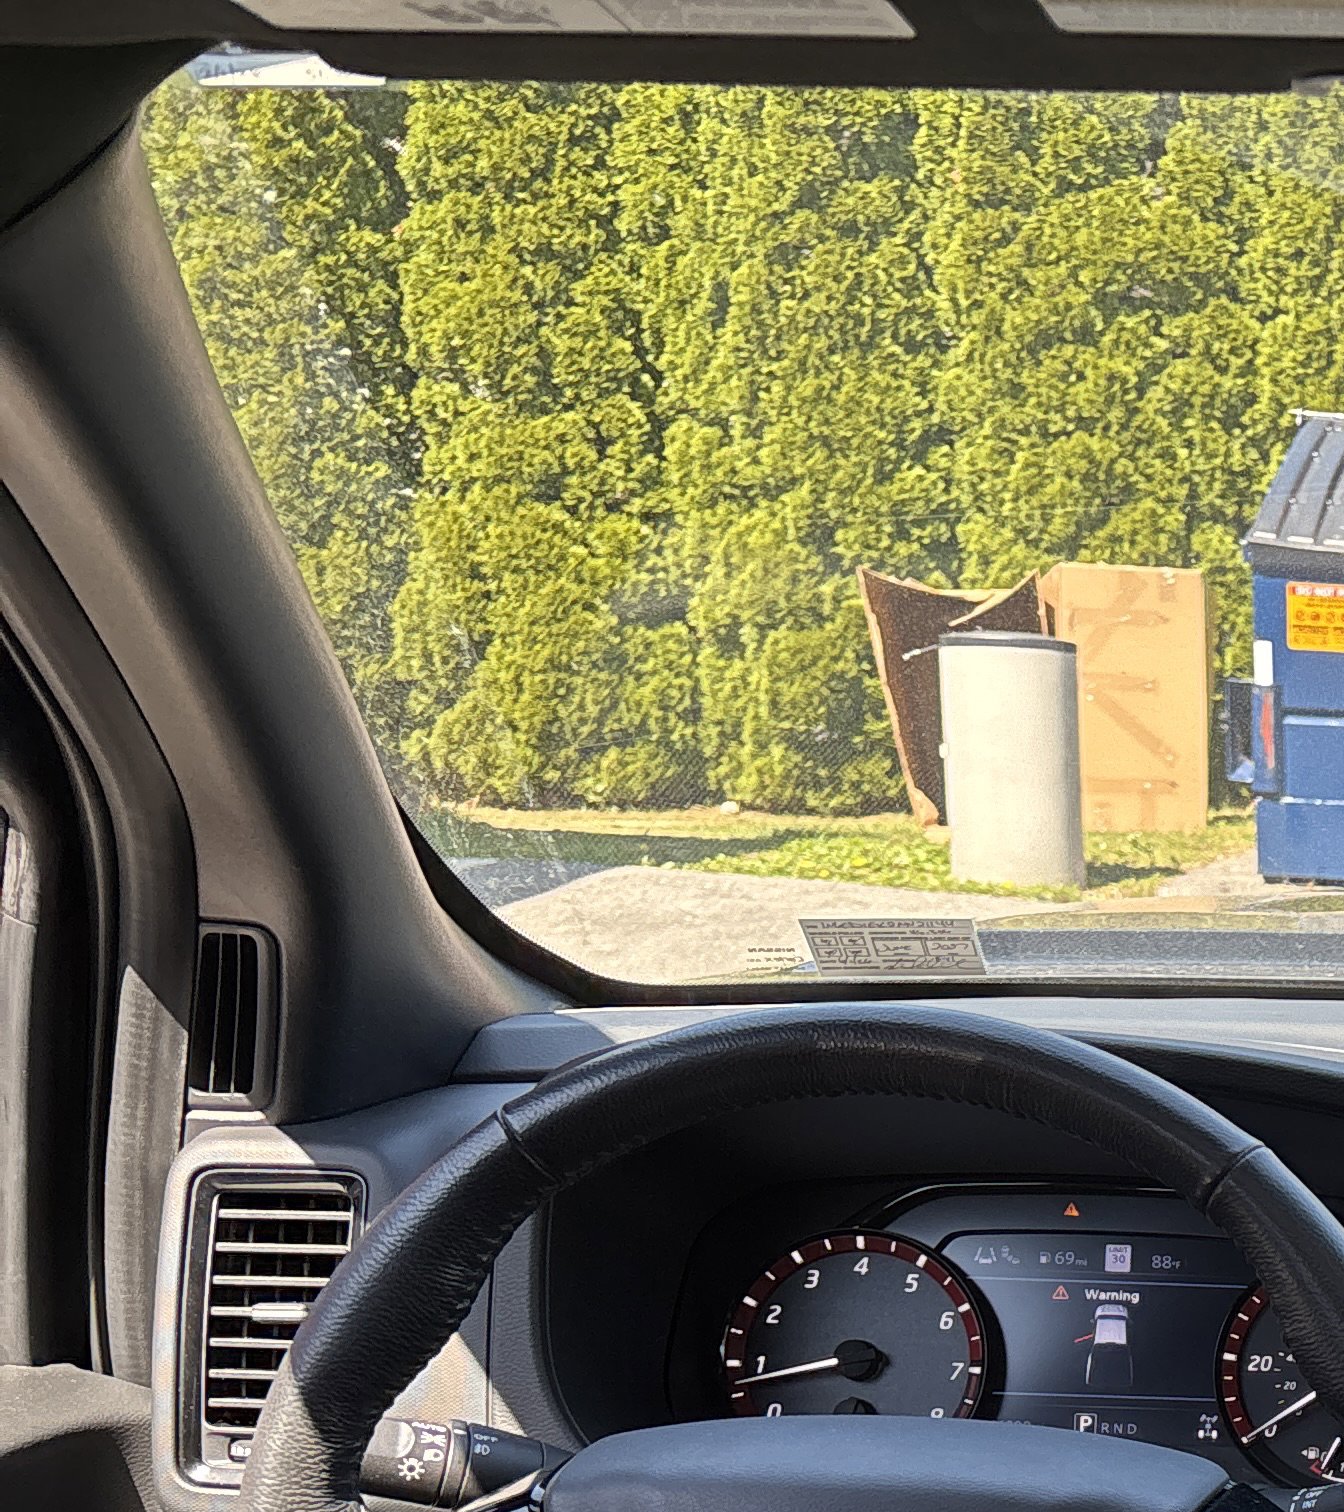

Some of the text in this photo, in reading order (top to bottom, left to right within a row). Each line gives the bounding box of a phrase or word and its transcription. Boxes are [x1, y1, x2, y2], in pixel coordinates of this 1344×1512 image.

[853, 1257, 870, 1275] 4
[1111, 1254, 1126, 1264] 30
[804, 1269, 820, 1289] 3
[904, 1273, 920, 1293] 5
[1085, 1289, 1140, 1304] Warning
[765, 1305, 782, 1324] 2
[939, 1311, 954, 1330] 6
[757, 1355, 766, 1374] 1
[950, 1362, 965, 1381] 7
[1248, 1355, 1273, 1372] 20
[1283, 1381, 1297, 1390] 20
[1080, 1415, 1137, 1435] P R N D
